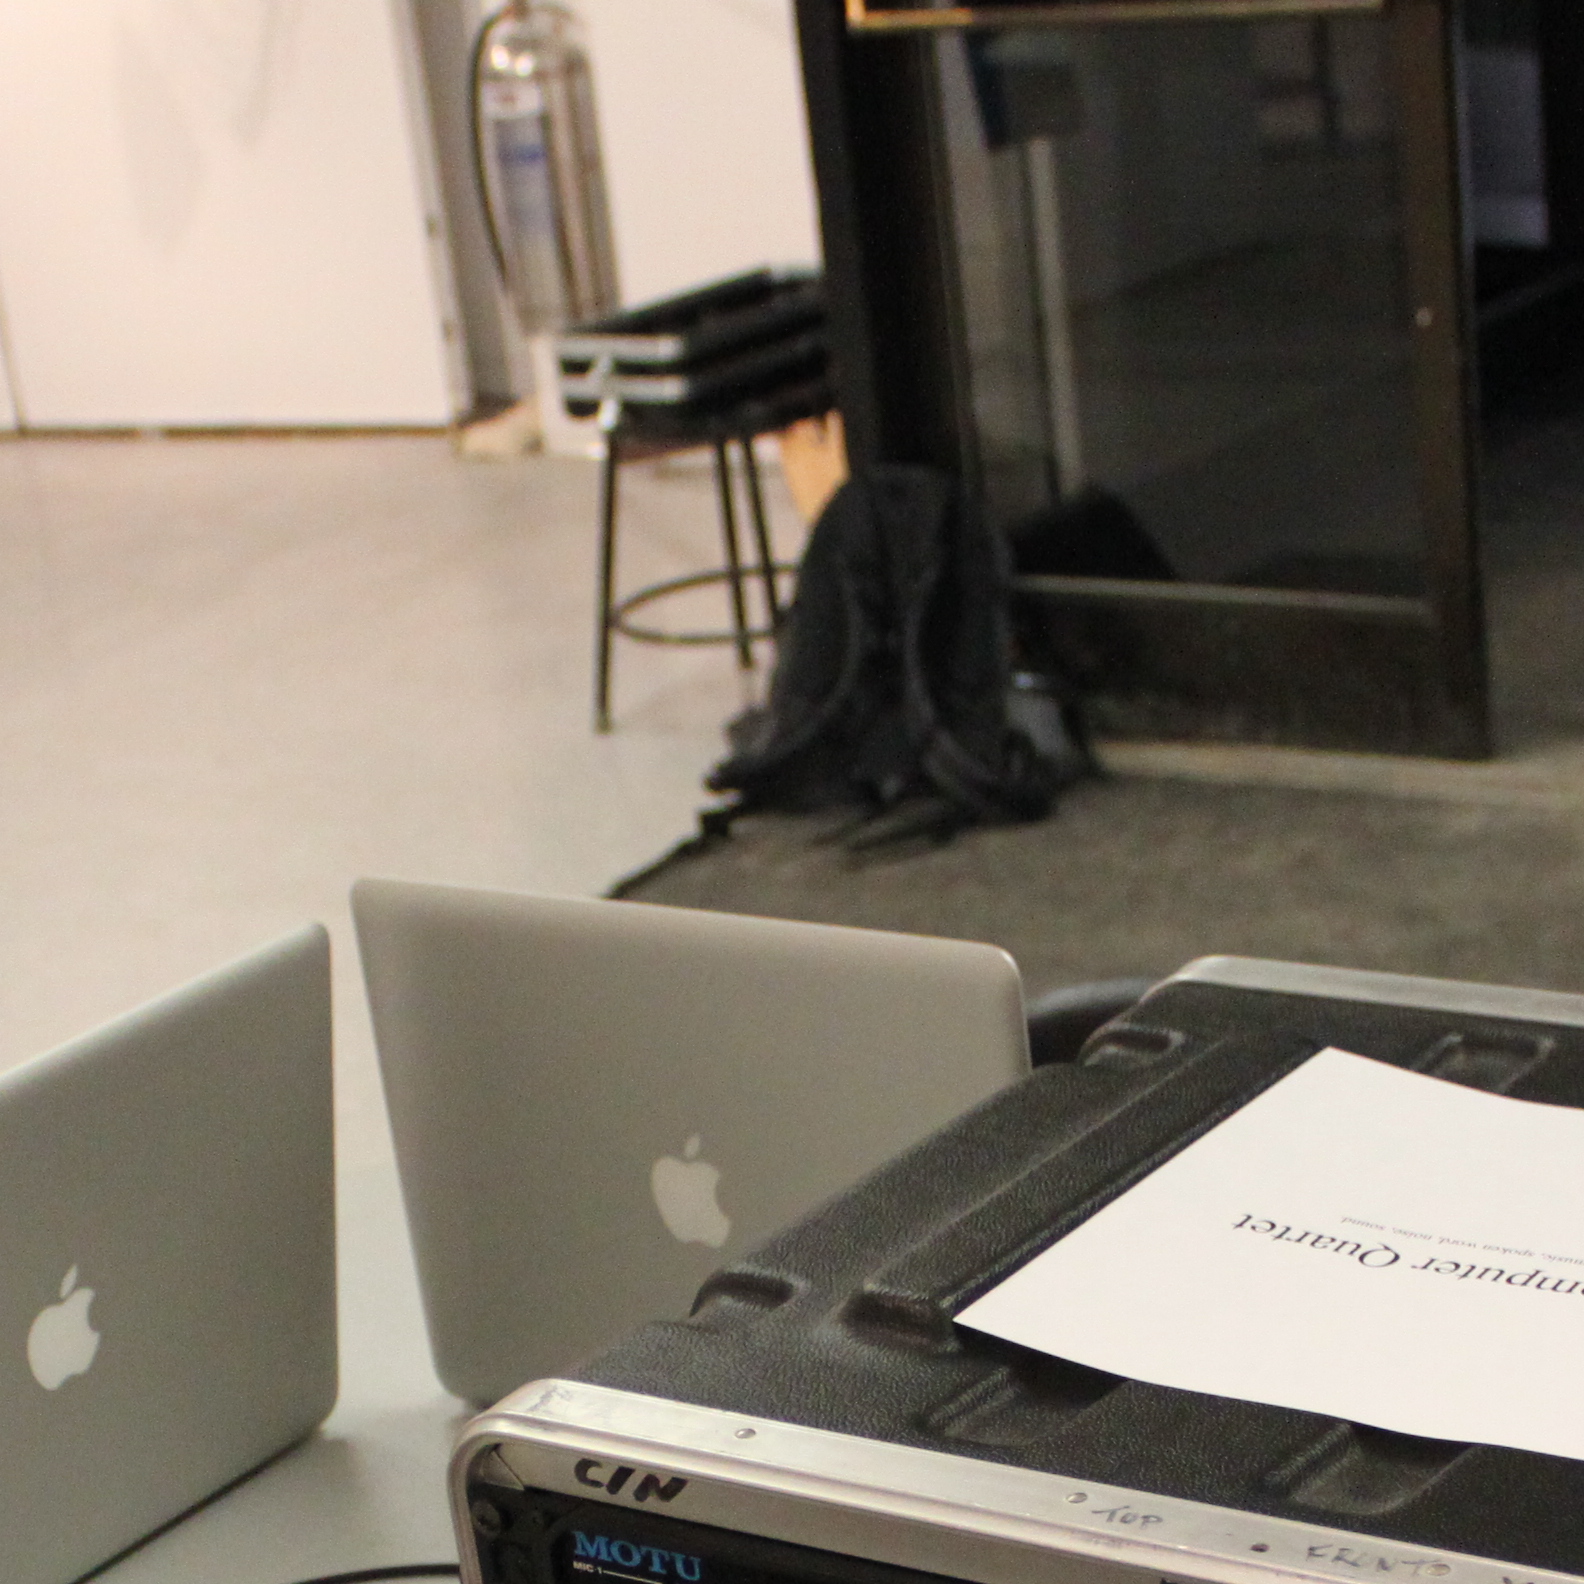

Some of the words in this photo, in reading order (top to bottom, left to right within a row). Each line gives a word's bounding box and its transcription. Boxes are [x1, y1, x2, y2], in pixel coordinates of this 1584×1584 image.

[1231, 1213, 1402, 1269] Quartet
[1482, 1244, 1535, 1259] spoken
[572, 1530, 703, 1581] MOTU
[572, 1561, 595, 1574] MIC
